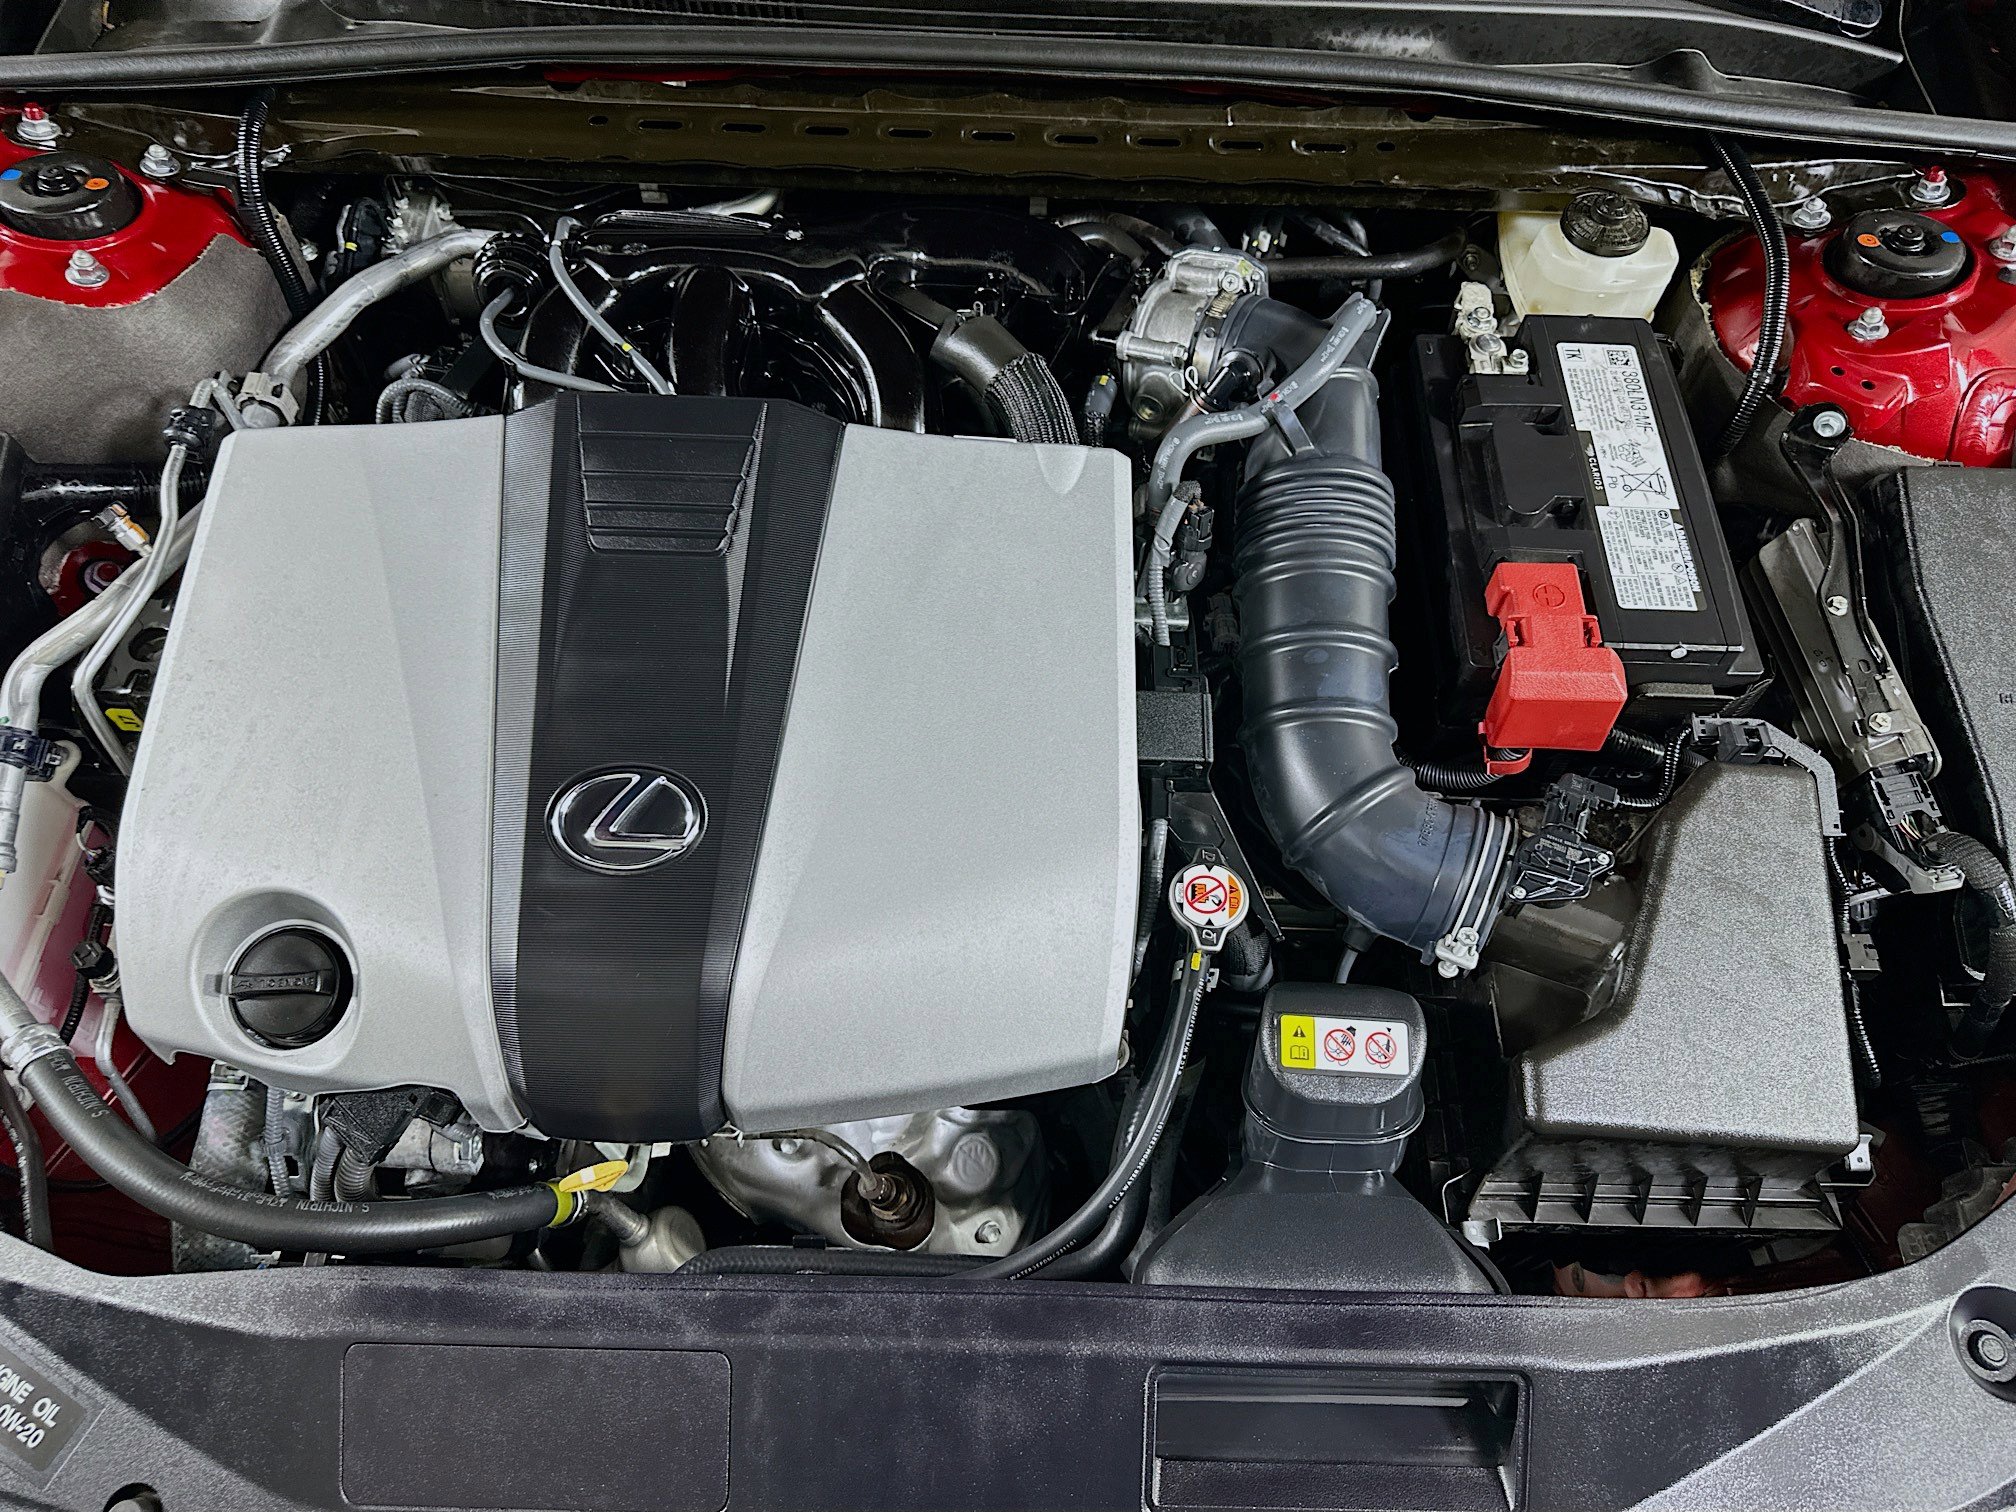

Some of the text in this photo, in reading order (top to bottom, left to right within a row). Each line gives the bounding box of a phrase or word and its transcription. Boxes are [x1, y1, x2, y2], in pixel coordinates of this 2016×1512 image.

[1564, 348, 1582, 359] TK
[1620, 371, 1653, 431] 380LN3-MF
[1588, 457, 1604, 490] CLARIOS
[1606, 476, 1619, 488] Pb
[0, 1364, 60, 1428] GINE OIL
